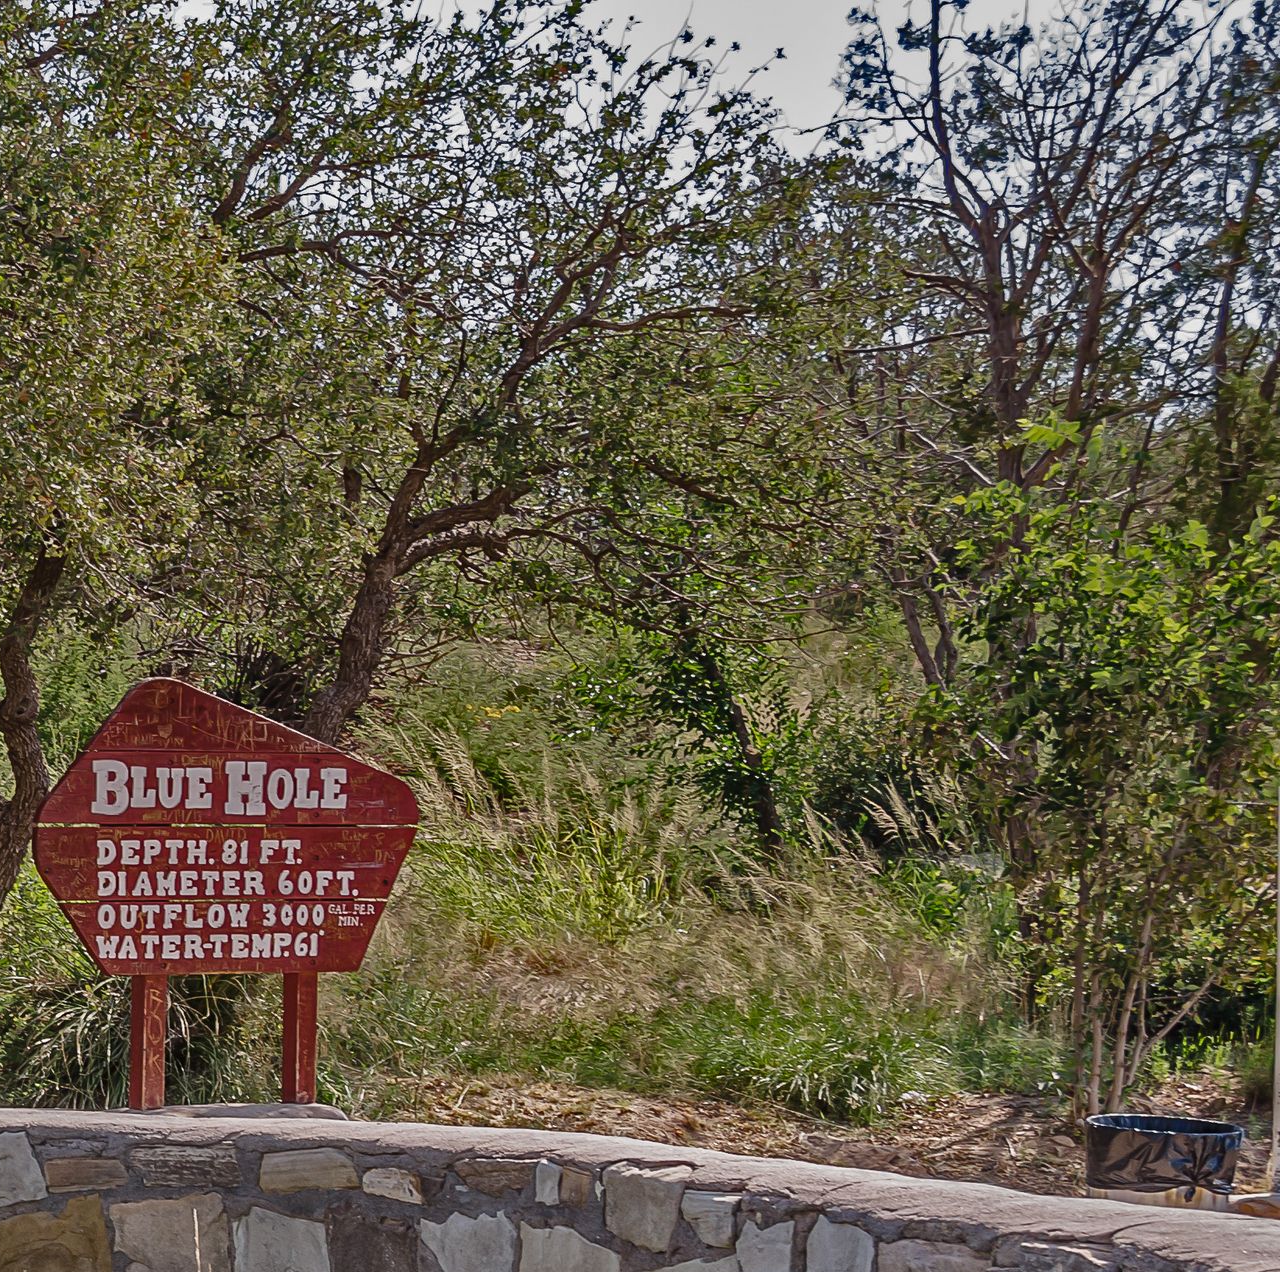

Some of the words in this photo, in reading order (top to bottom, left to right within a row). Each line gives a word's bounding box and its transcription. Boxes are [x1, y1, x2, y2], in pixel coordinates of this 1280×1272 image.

[91, 759, 213, 816] BLUE
[224, 760, 348, 816] HOLE
[259, 839, 303, 865] FT.
[97, 870, 266, 897] DIAMETER
[97, 903, 251, 930] OUTFLOW
[262, 903, 325, 927] 3000
[337, 915, 364, 927] MIN.
